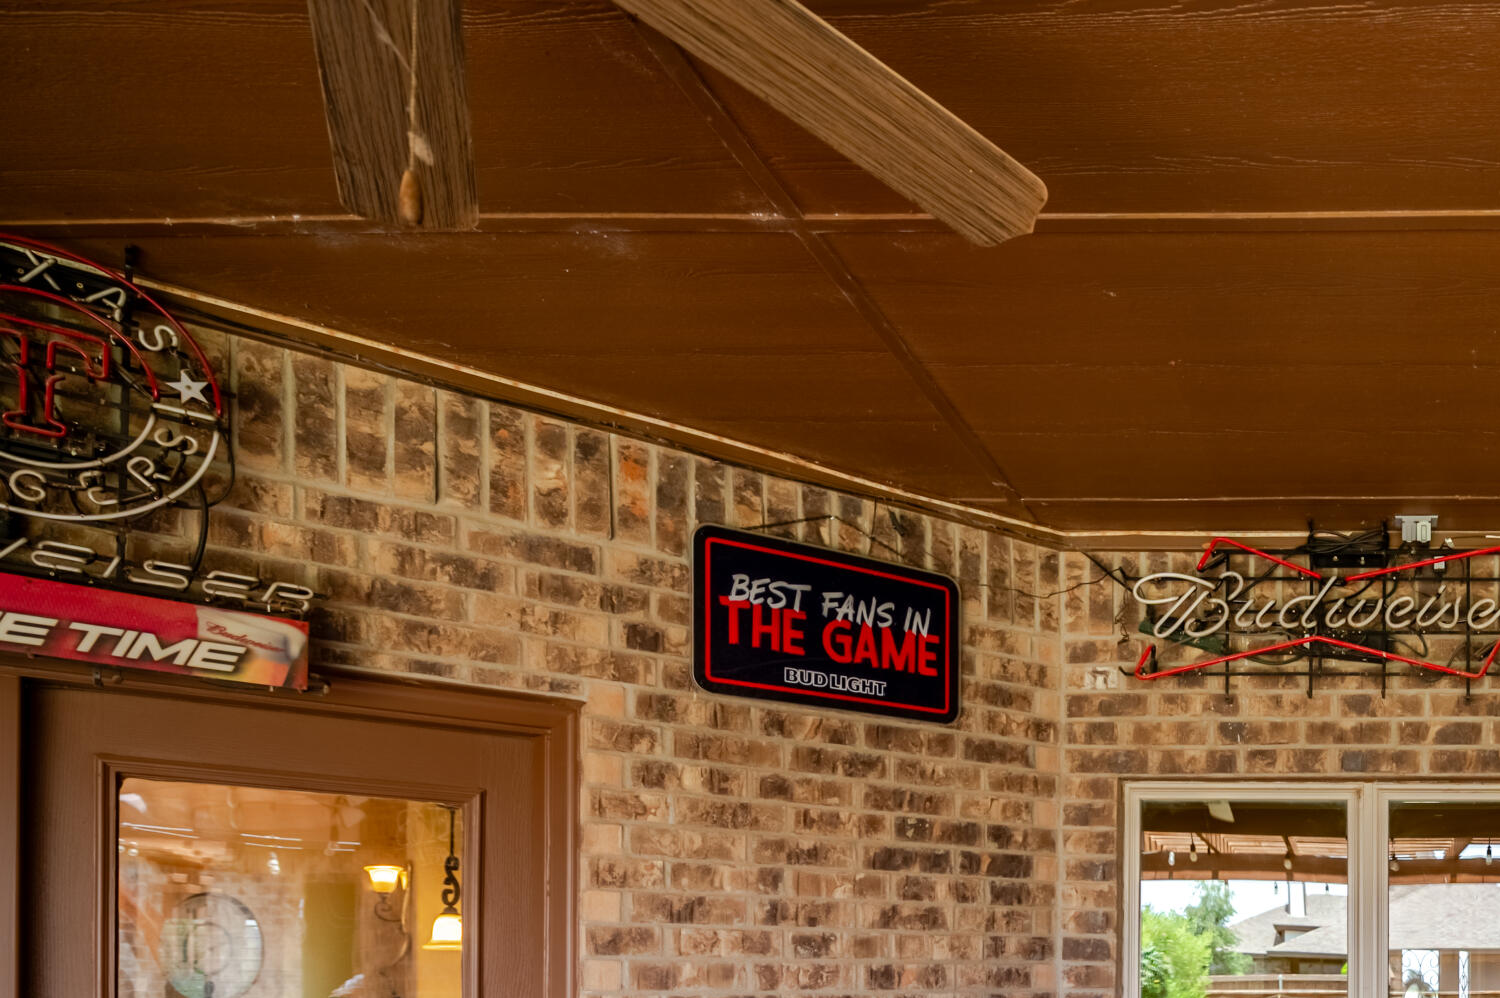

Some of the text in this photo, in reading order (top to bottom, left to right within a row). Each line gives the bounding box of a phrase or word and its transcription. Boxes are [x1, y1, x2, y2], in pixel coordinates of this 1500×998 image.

[18, 248, 179, 352] XAS
[9, 427, 199, 506] GERS
[0, 537, 314, 613] EISER
[728, 574, 931, 638] BEST FANS IN
[0, 612, 248, 673] E TIME
[719, 595, 940, 677] THE GAME
[784, 667, 887, 697] BUD LIGHT
